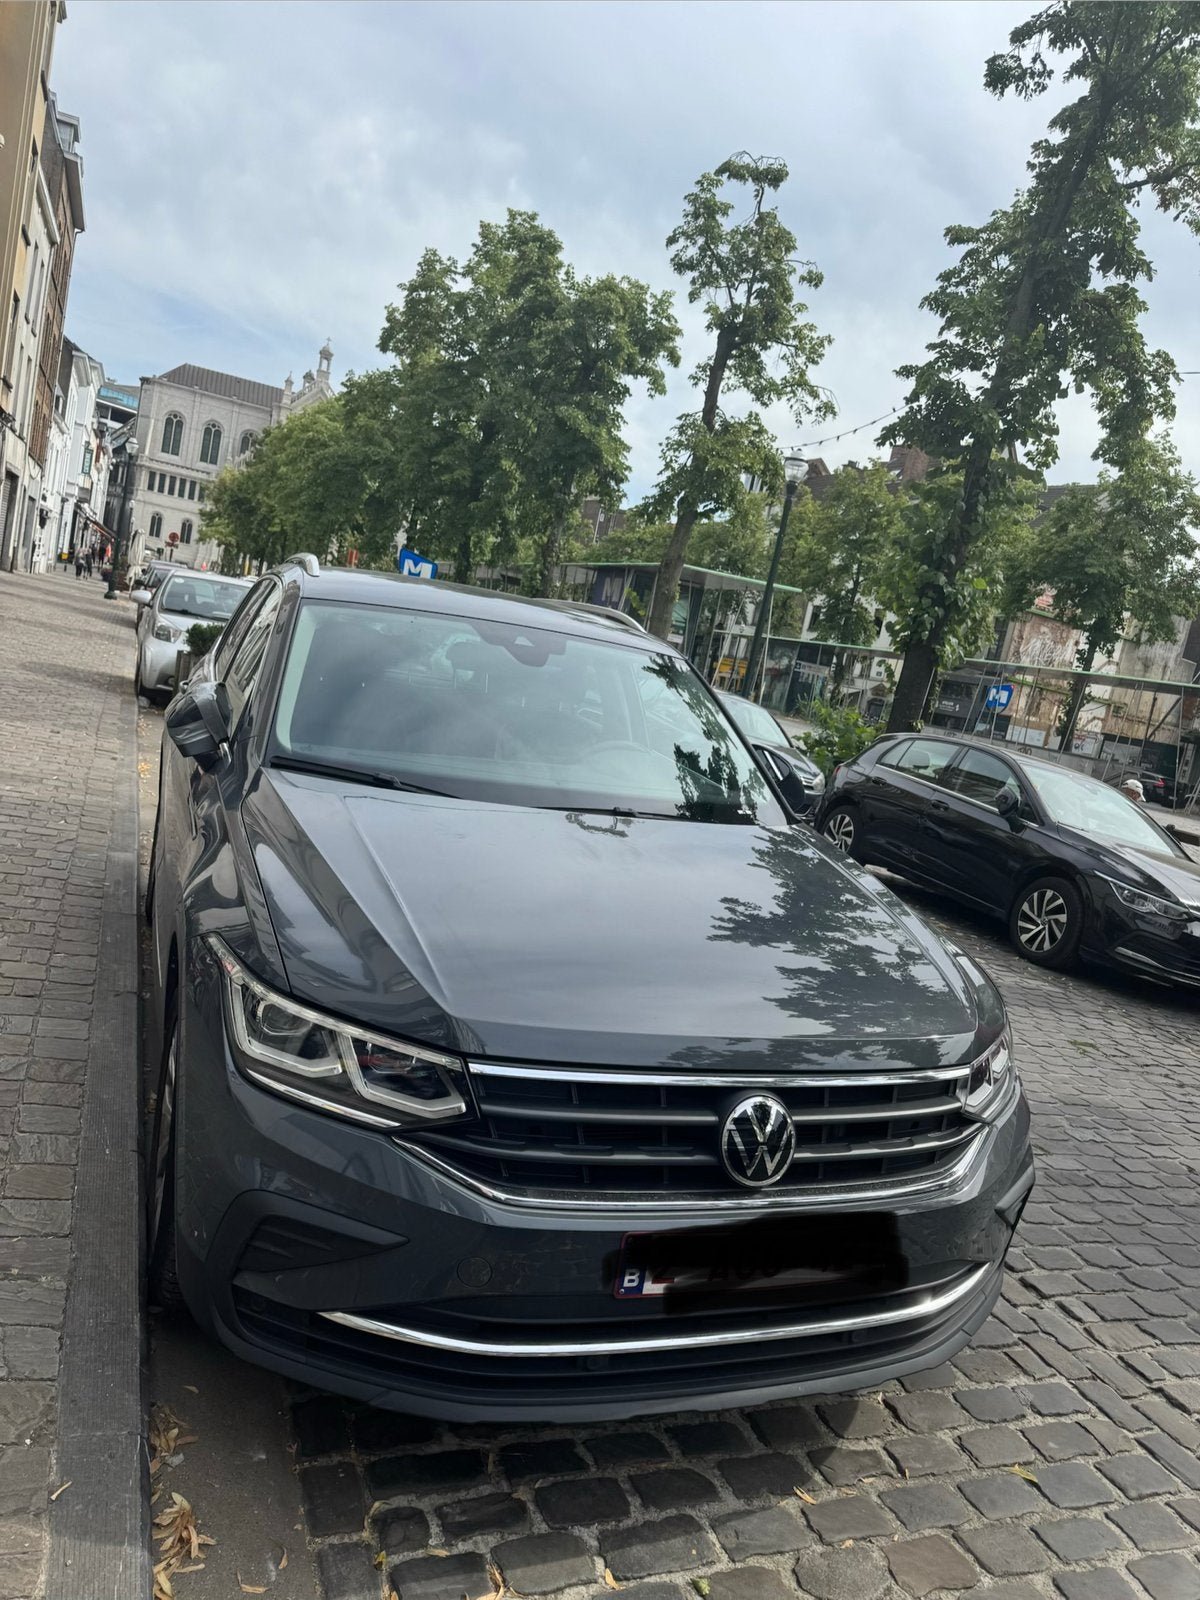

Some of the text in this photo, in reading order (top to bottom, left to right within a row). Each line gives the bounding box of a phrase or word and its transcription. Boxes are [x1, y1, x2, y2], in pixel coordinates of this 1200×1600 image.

[403, 558, 433, 578] M
[601, 577, 623, 602] M
[988, 688, 1009, 704] M
[724, 1101, 794, 1179] VW
[623, 1269, 640, 1287] B
